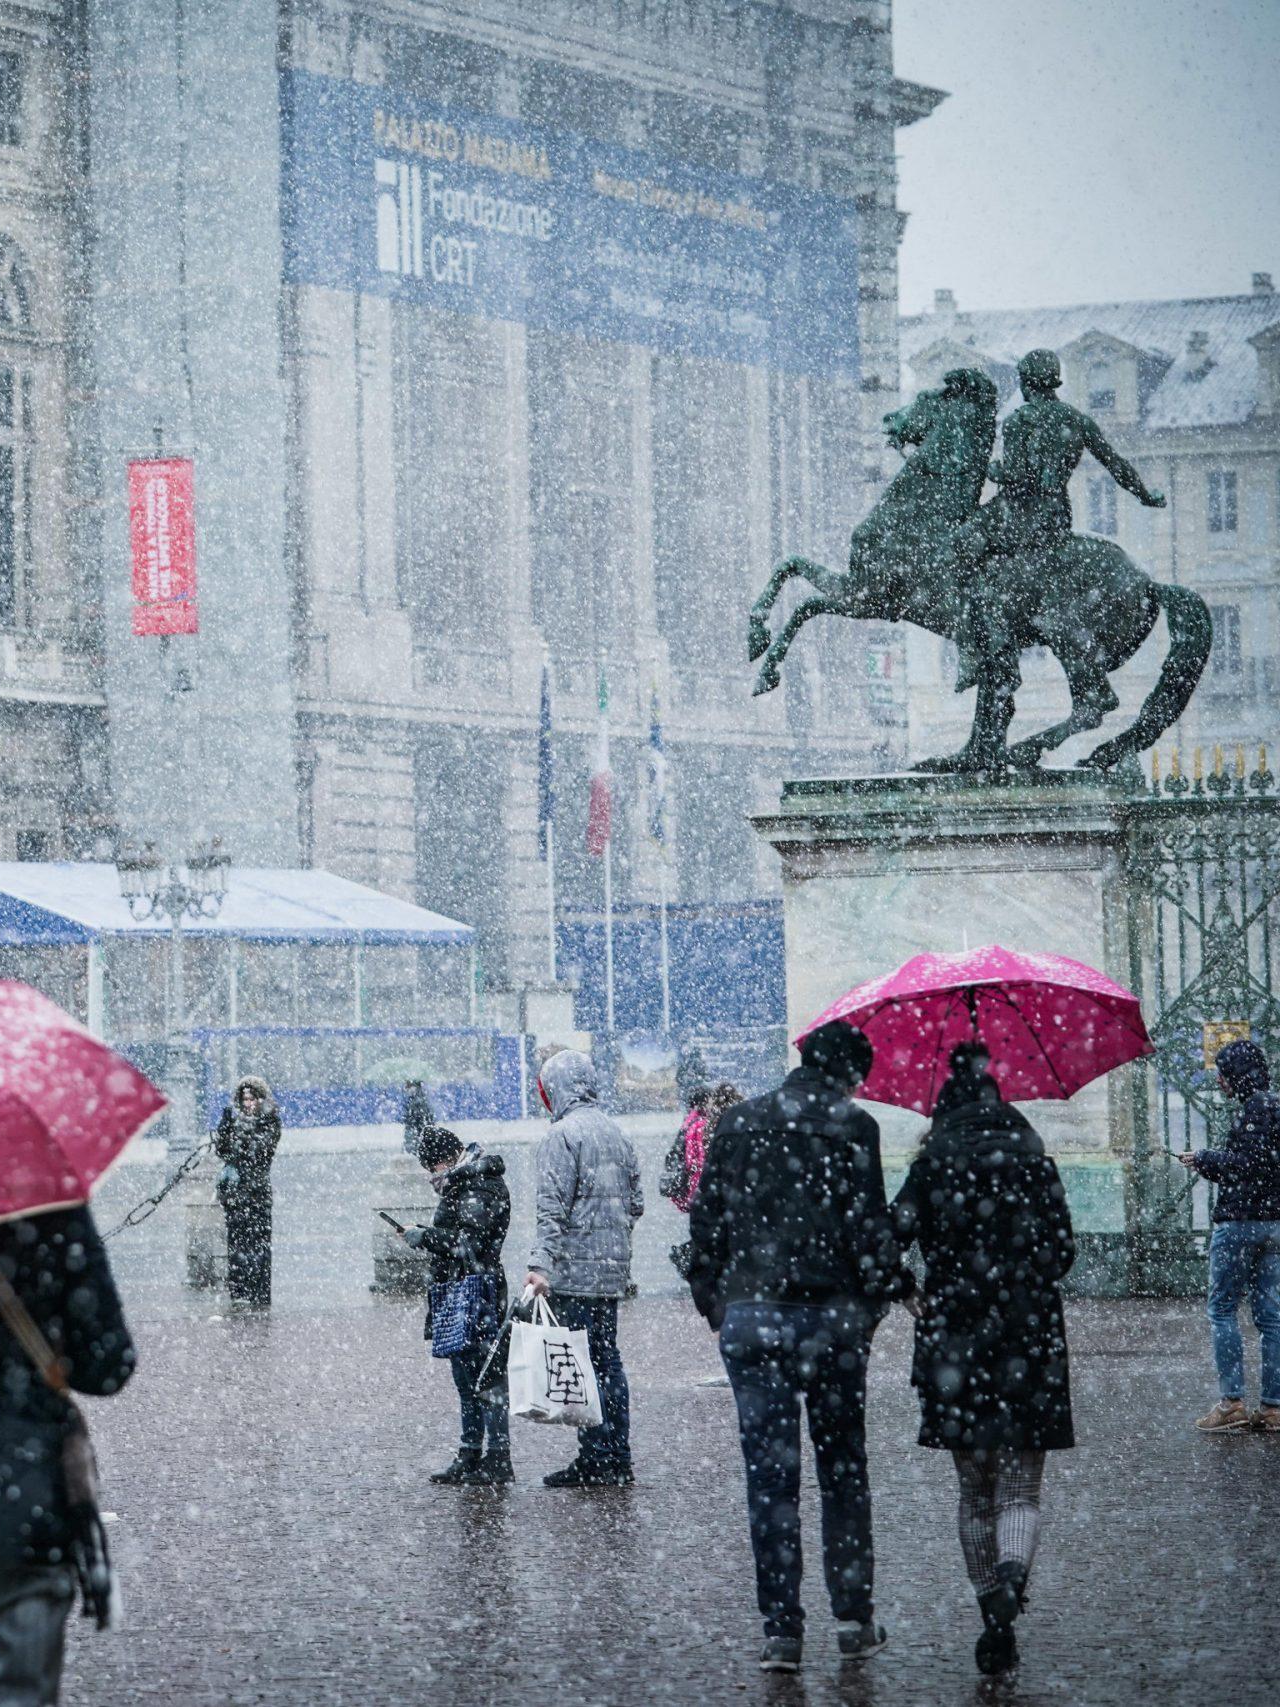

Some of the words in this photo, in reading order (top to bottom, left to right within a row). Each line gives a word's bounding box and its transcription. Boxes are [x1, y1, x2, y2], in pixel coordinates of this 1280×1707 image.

[373, 109, 460, 161] PALAZZO
[464, 130, 552, 181] MADAMA
[428, 170, 554, 241] Fondazione
[430, 234, 478, 286] CRT
